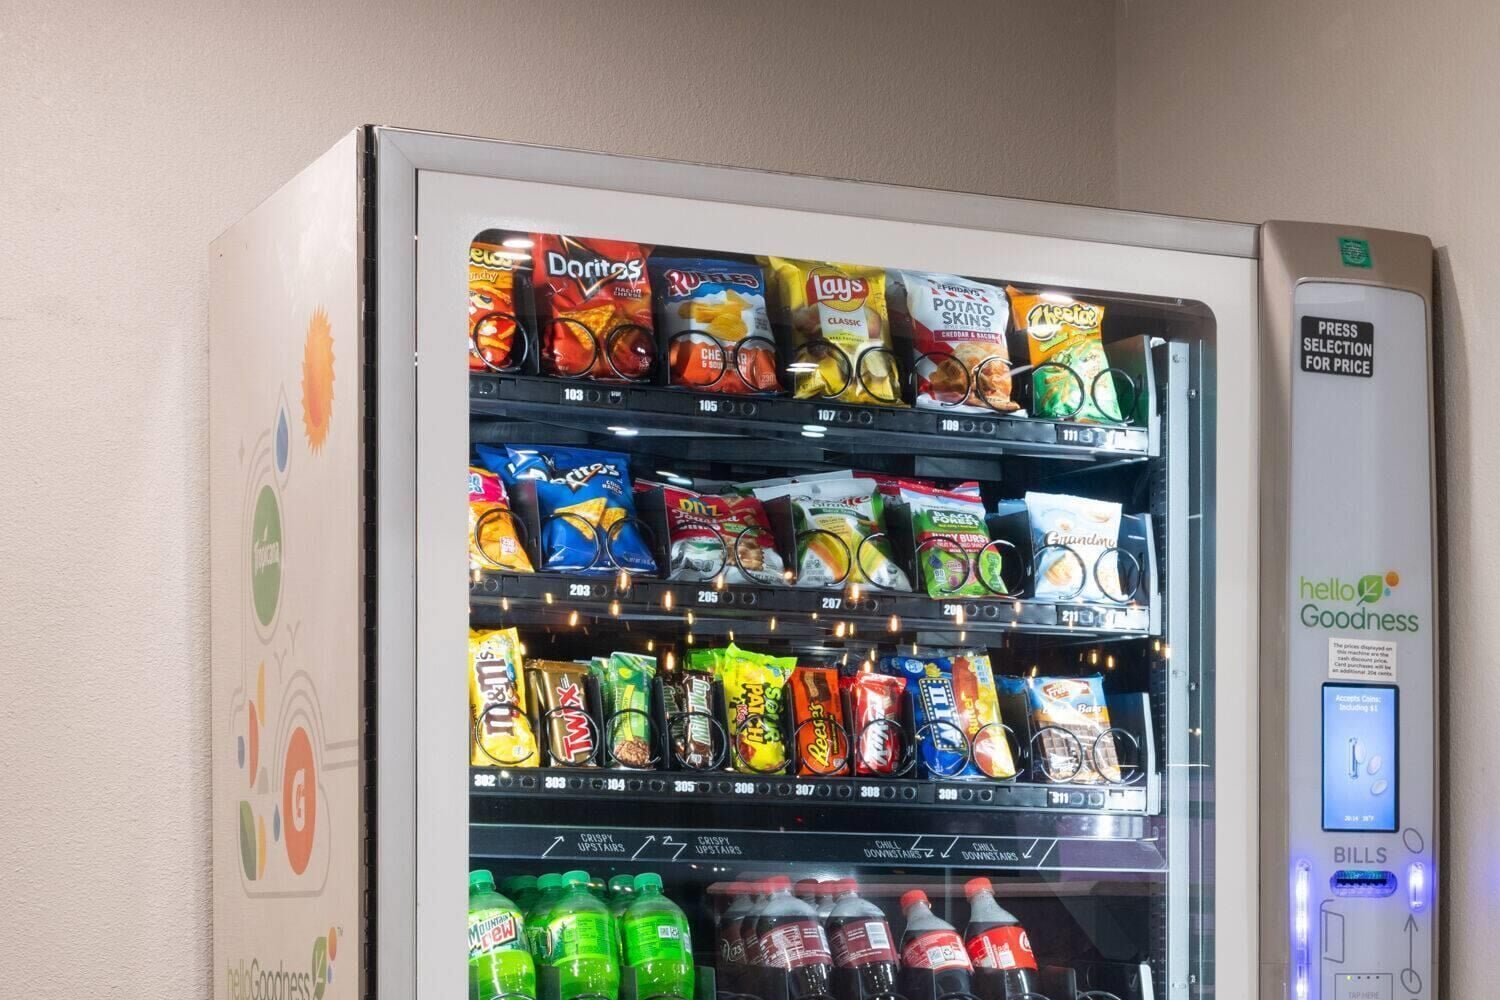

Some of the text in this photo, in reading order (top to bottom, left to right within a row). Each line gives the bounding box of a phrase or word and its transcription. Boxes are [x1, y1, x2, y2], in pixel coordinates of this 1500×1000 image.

[549, 252, 641, 280] Doritos
[664, 269, 760, 297] RUFFLES
[933, 298, 995, 316] POTATO
[828, 317, 863, 327] CLASSIC
[942, 312, 991, 328] SKINS
[1318, 320, 1358, 338] PRESS
[1303, 337, 1373, 357] SELECTION
[1305, 355, 1370, 375] FOR PRICE
[564, 388, 584, 401] 103
[699, 400, 718, 412] 105
[817, 409, 836, 421] 107
[942, 419, 959, 431] 109
[1063, 429, 1079, 441] 111
[932, 510, 974, 520] BLACK
[932, 516, 980, 526] FOREST
[569, 584, 591, 597] 203
[1300, 575, 1356, 602] hello
[698, 591, 719, 603] 205
[822, 598, 842, 610] 207
[1301, 603, 1420, 633] Goodness
[808, 702, 830, 767] Reese's
[474, 774, 496, 787] 302
[545, 776, 566, 789] 303
[675, 781, 695, 793] 305
[735, 783, 754, 794] 306
[796, 784, 815, 796] 307
[861, 786, 880, 798] 308
[939, 788, 958, 800] 309
[580, 833, 614, 843] CRISPY
[697, 836, 731, 846] CRISPY
[577, 843, 626, 853] UPSTAIRS
[695, 845, 743, 855] UPSTAIRS
[875, 840, 902, 850] CHILL
[972, 842, 999, 852] CHILL
[864, 849, 922, 859] DOWNSTAIRS
[961, 851, 1019, 861] DOWNSTAIRS
[1334, 846, 1388, 864] BILLS
[1348, 992, 1380, 1000] TAP HERE
